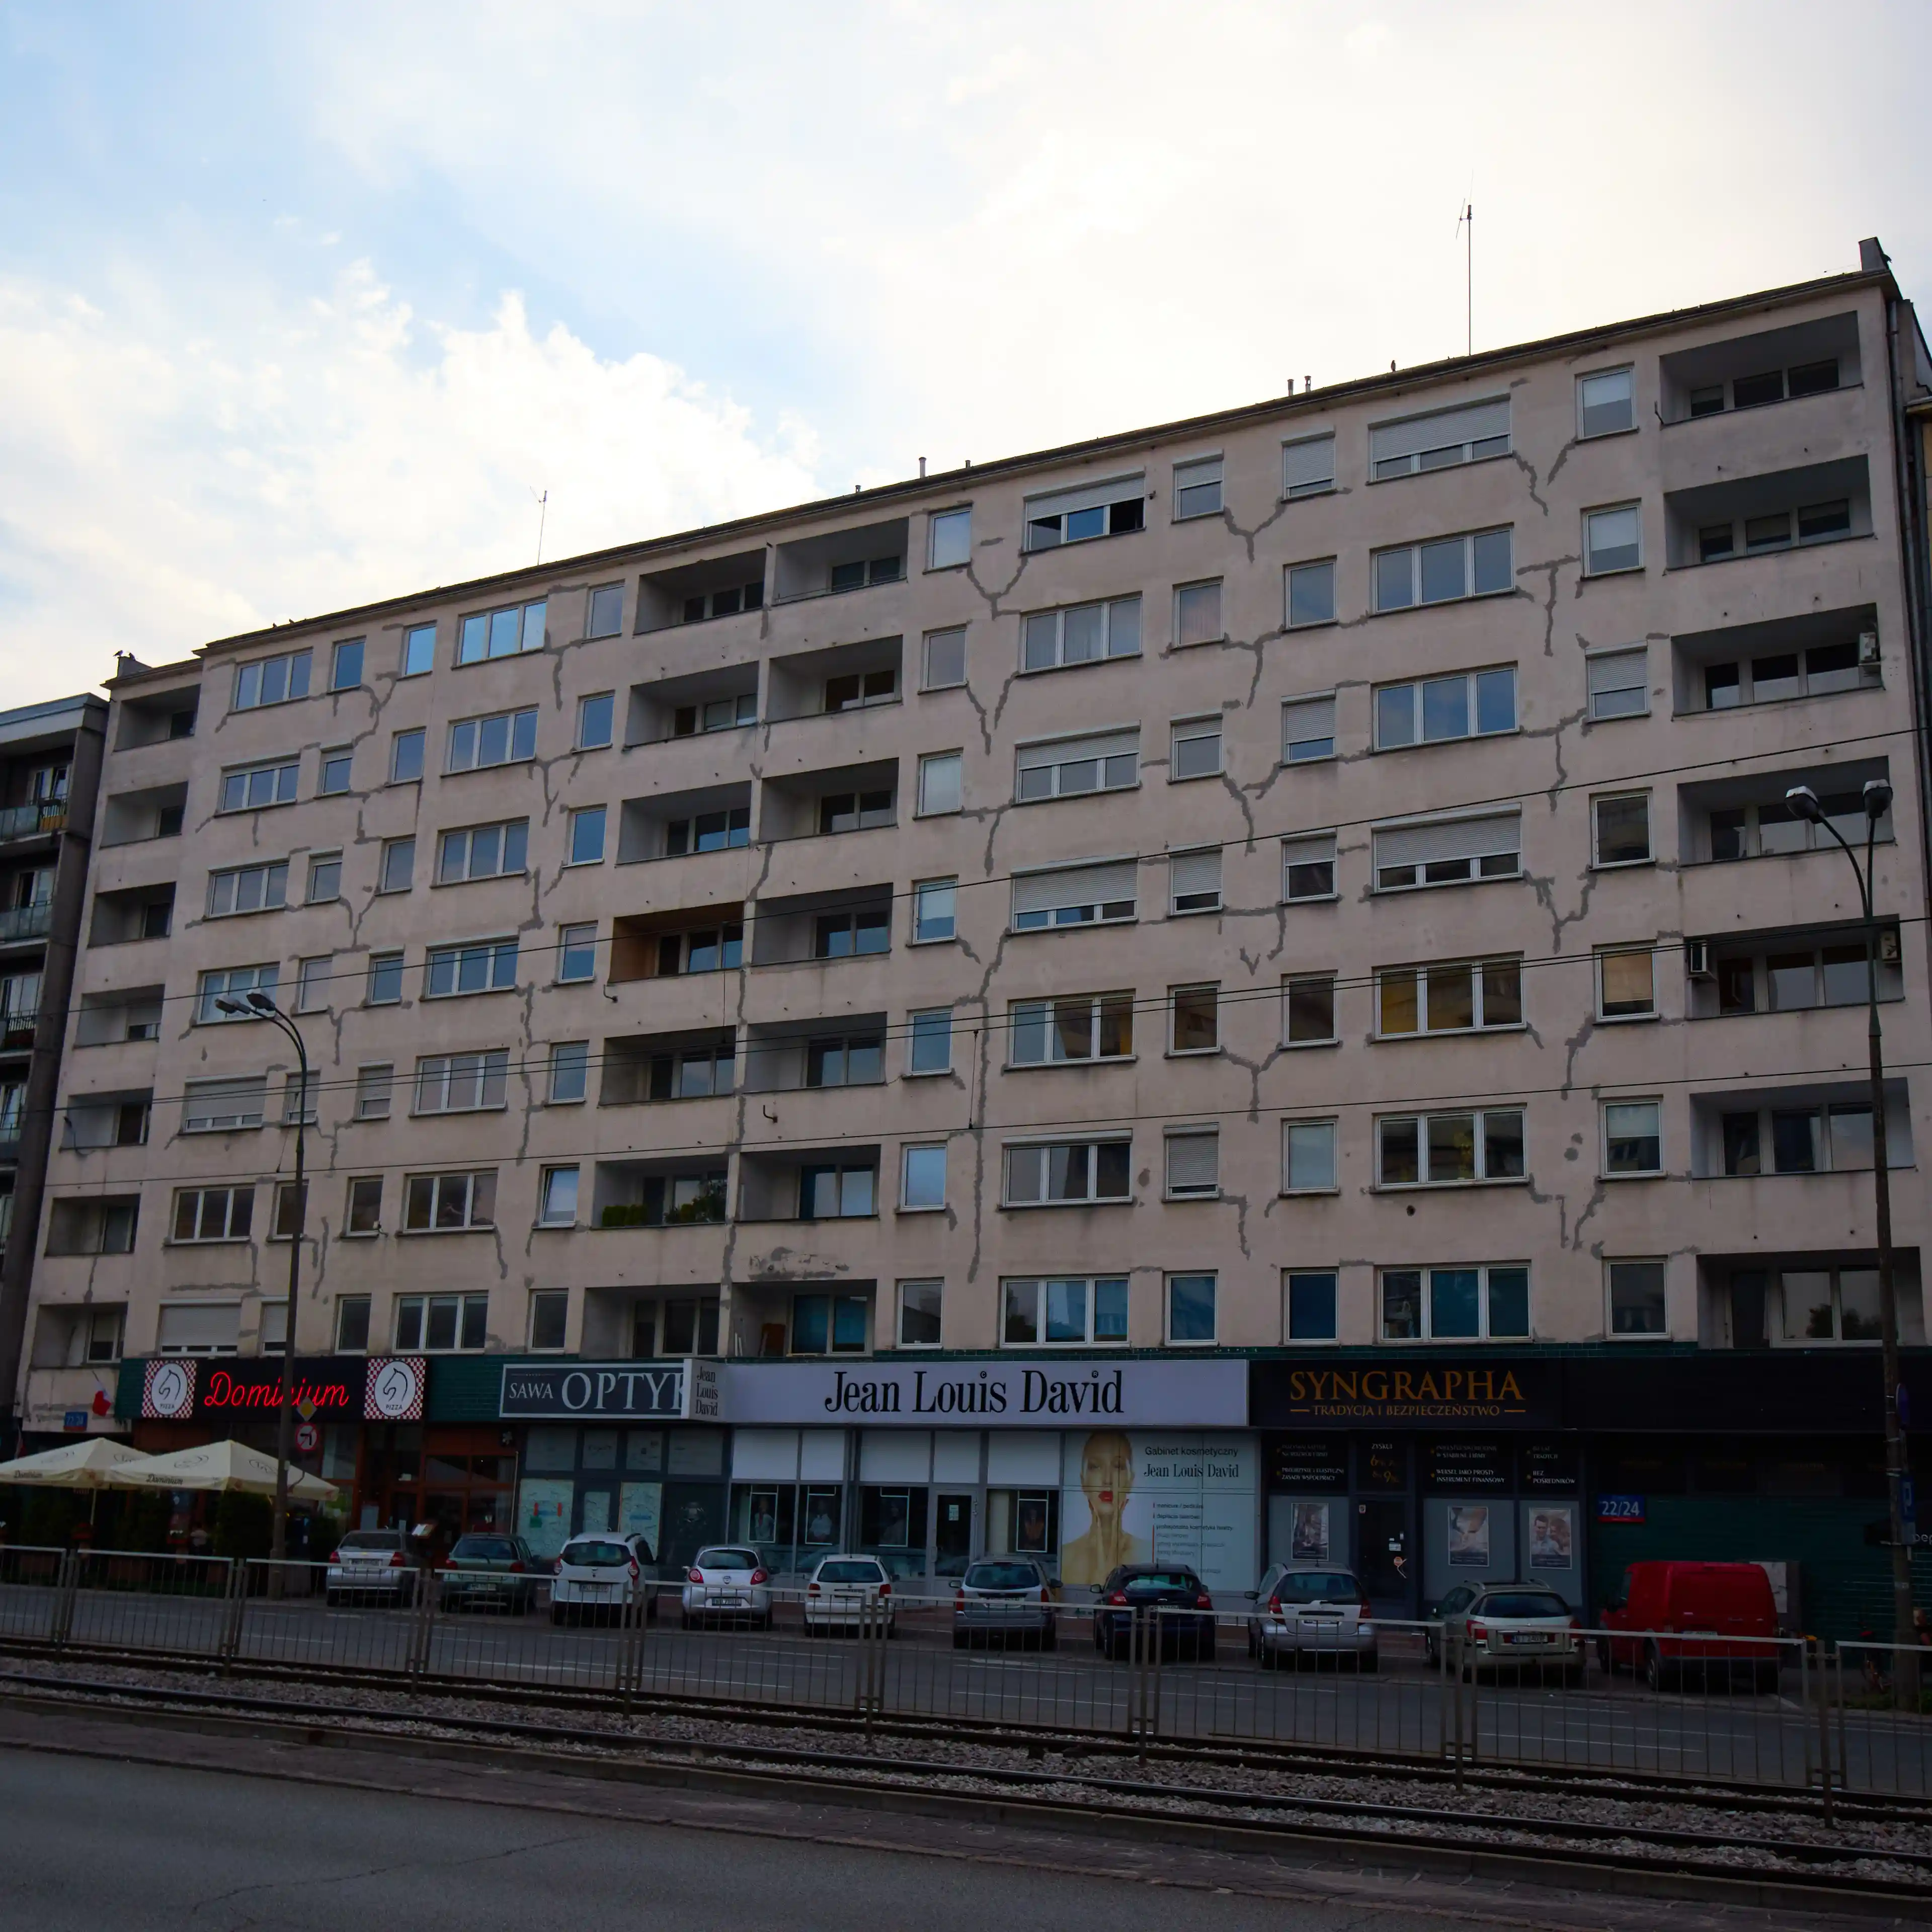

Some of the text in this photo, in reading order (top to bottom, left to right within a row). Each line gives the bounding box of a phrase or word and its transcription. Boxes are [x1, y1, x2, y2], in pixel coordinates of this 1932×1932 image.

[696, 1365, 715, 1383] Jean
[204, 1371, 349, 1407] Domiium
[509, 1382, 553, 1399] SAWA
[696, 1383, 718, 1400] Louis
[825, 1370, 1124, 1413] Jean Louis David
[1290, 1370, 1525, 1401] SYNGRAPHA
[695, 1400, 717, 1416] David
[1312, 1403, 1500, 1416] TRADYCJA I BEZPIECZEŃSTWO
[1145, 1446, 1238, 1457] Gabinet kosmetyczny
[1144, 1464, 1239, 1478] Jean Louis David
[1601, 1501, 1640, 1516] 22/24
